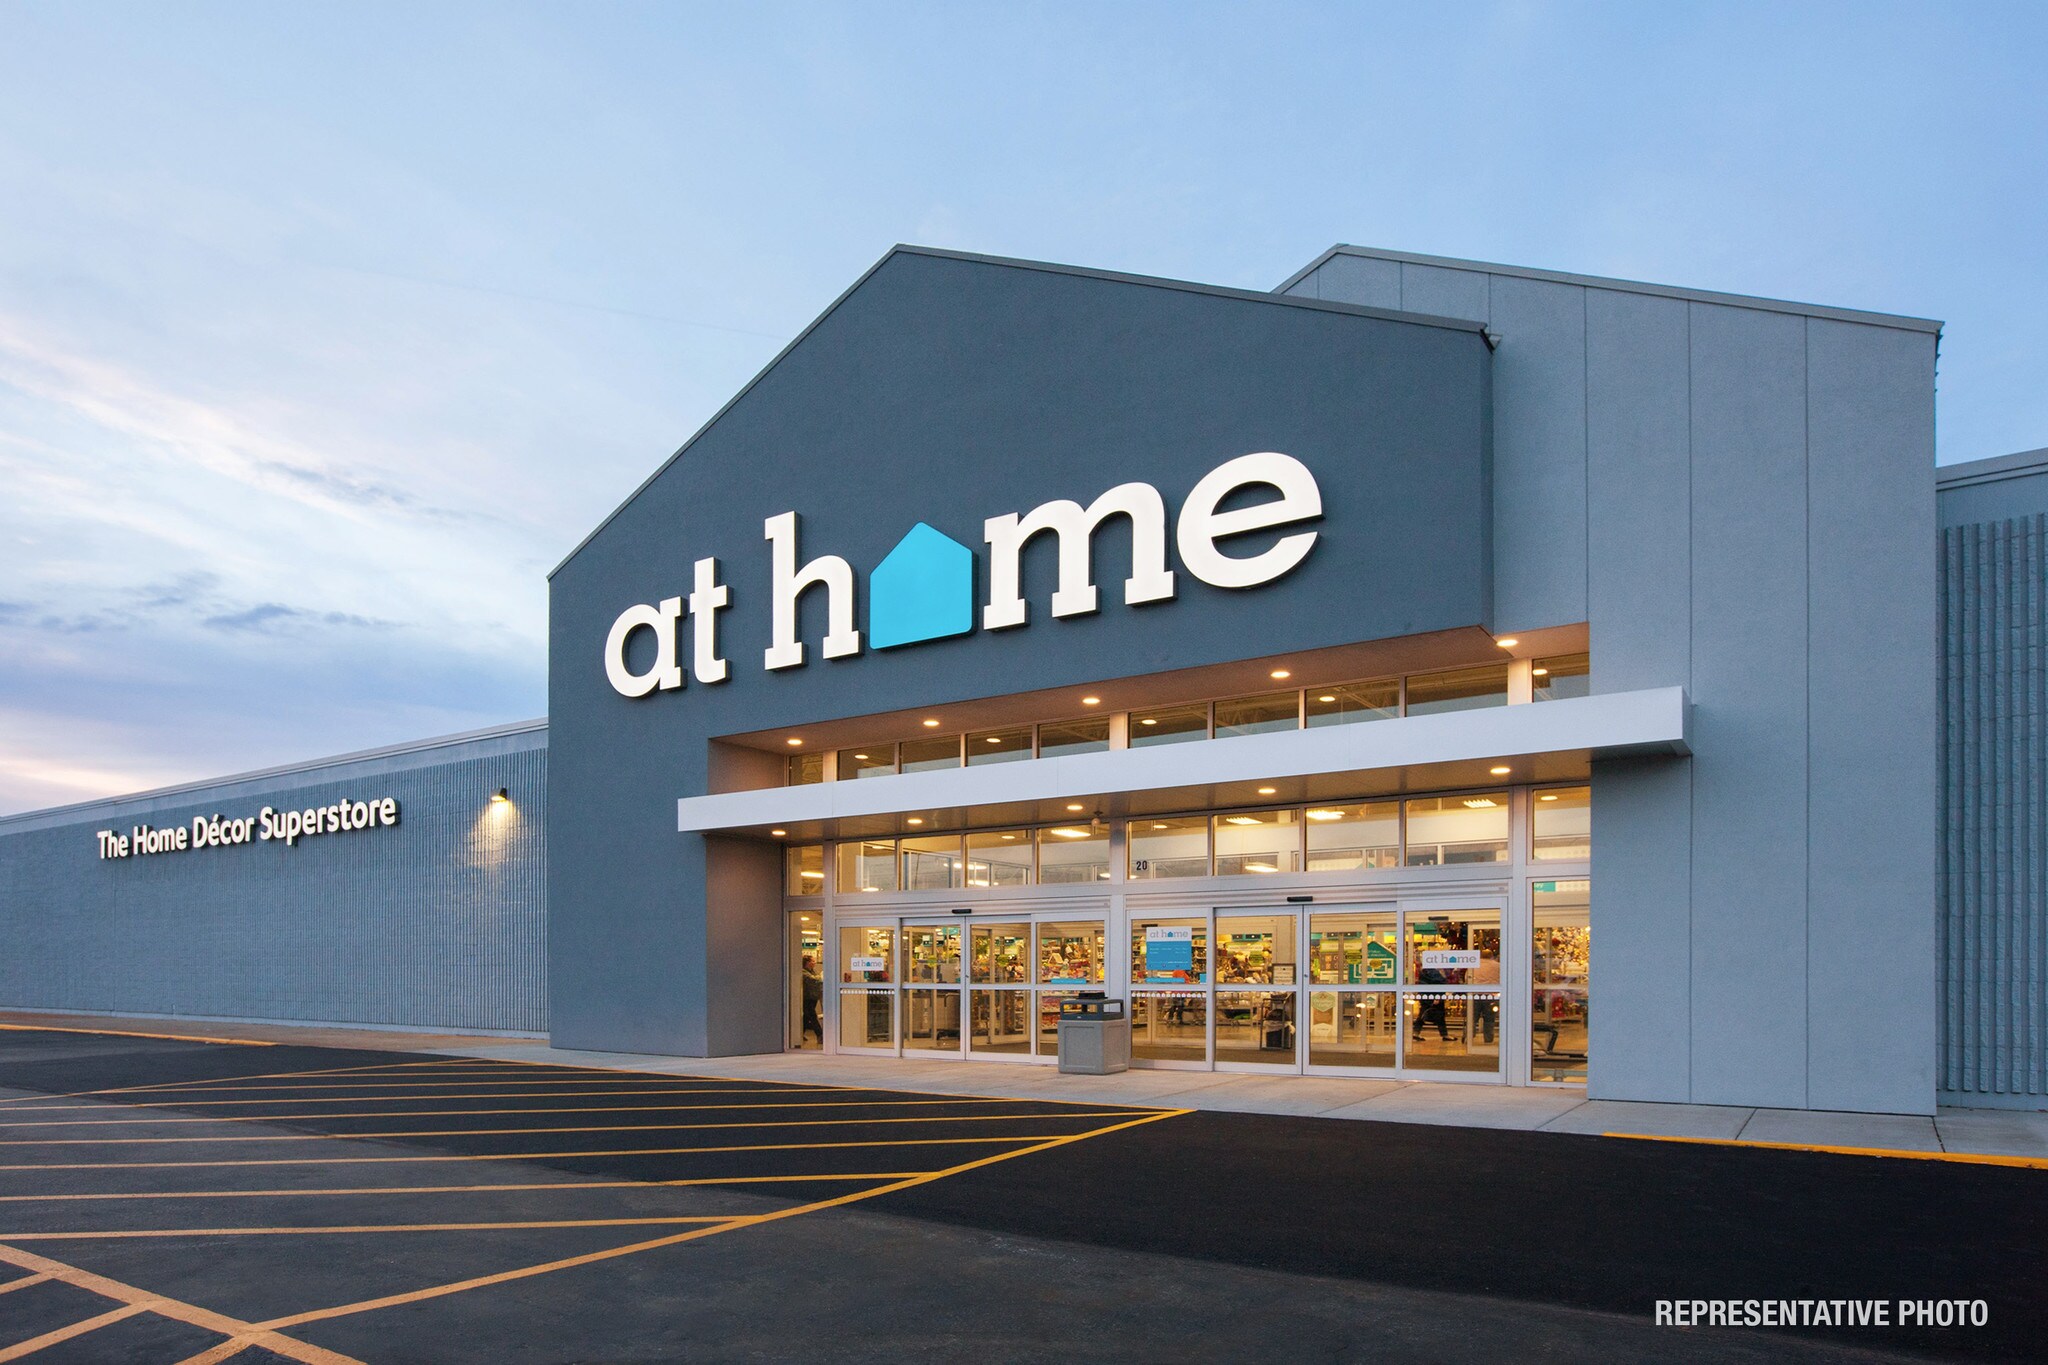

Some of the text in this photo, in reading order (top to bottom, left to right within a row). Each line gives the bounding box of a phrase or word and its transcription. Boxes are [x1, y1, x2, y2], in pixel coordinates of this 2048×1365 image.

[604, 556, 732, 699] at
[97, 797, 396, 860] The Home Décor Superstore
[1136, 860, 1148, 871] 20
[1150, 930, 1160, 938] at
[1425, 955, 1438, 964] at
